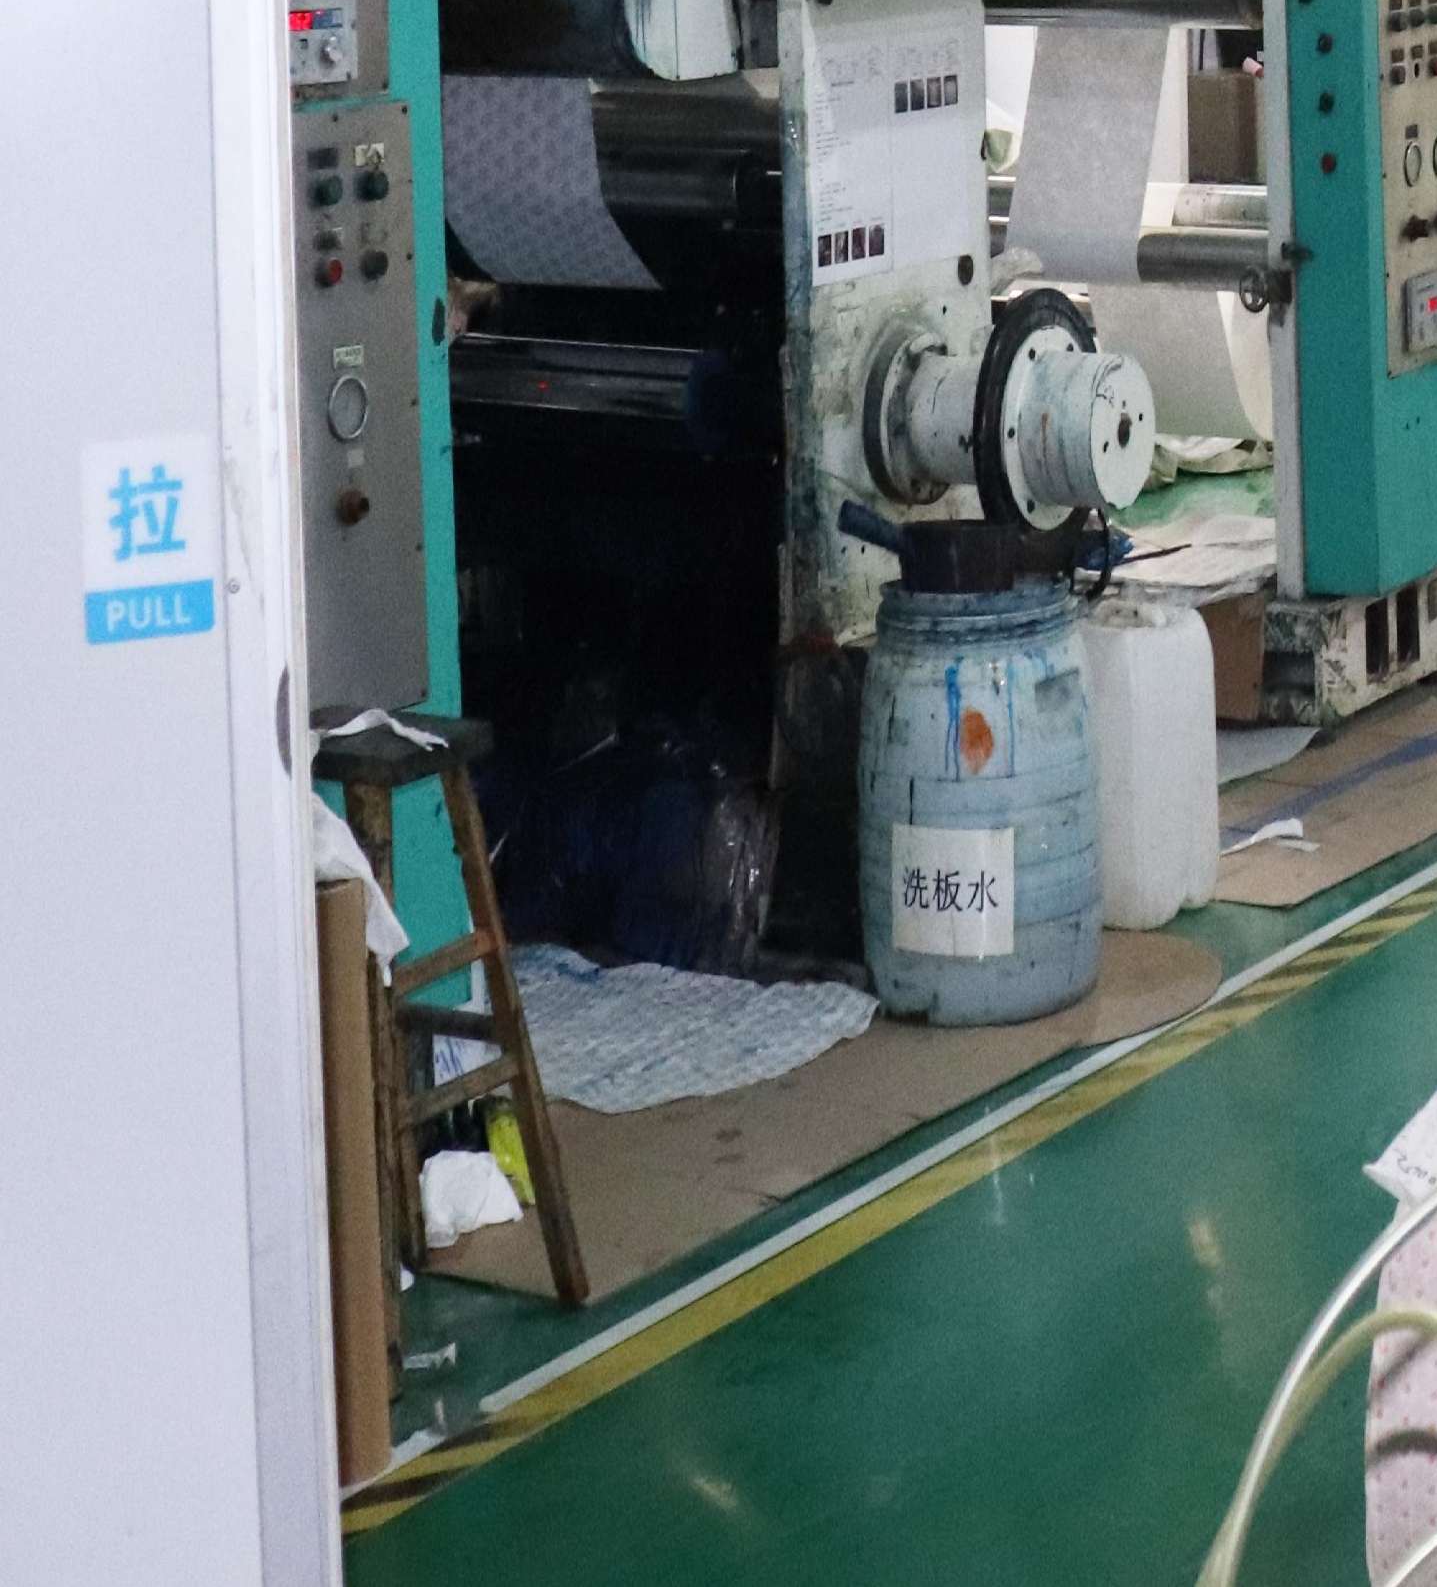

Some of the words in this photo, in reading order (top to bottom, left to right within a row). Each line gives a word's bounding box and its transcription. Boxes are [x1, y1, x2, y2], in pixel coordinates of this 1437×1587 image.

[108, 463, 186, 562] 拉
[106, 595, 191, 632] PULL
[902, 865, 999, 913] 洗板水
